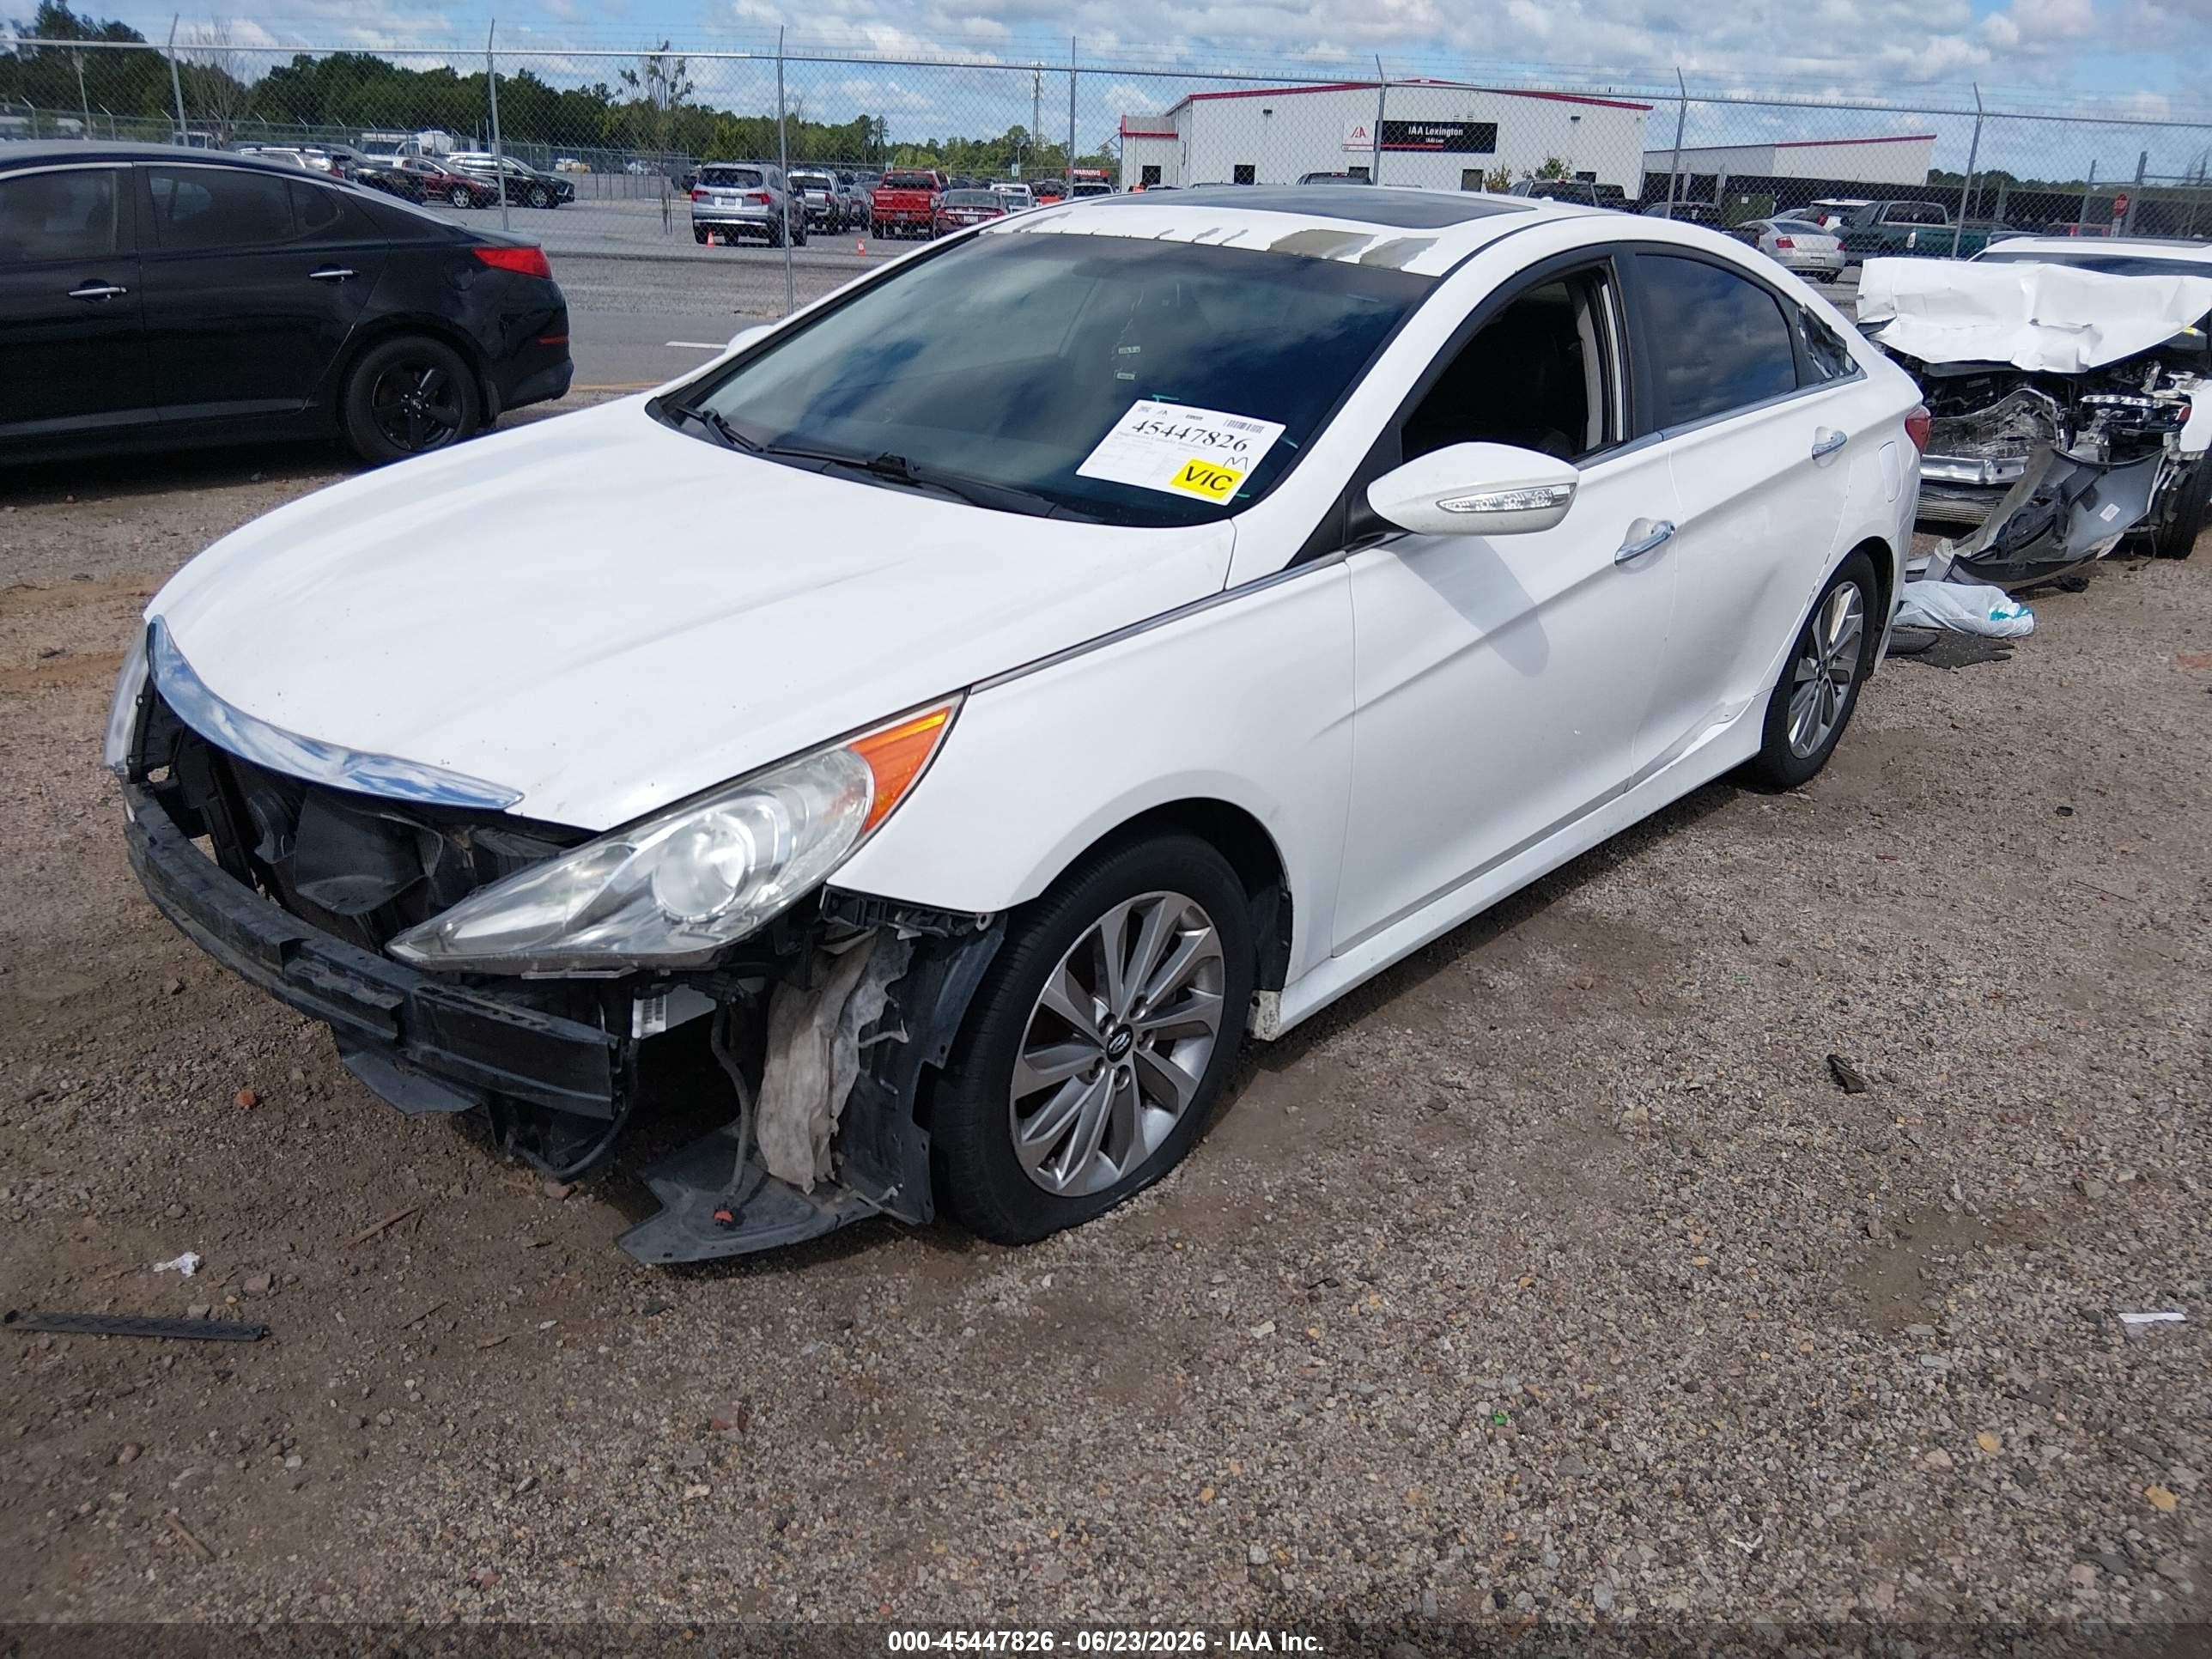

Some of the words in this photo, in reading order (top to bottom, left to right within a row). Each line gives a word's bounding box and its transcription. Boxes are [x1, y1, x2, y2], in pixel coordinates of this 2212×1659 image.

[1408, 125, 1424, 136] IAA
[1425, 125, 1463, 137] Lexington
[1132, 419, 1250, 453] 45447826
[1185, 465, 1233, 492] VIC
